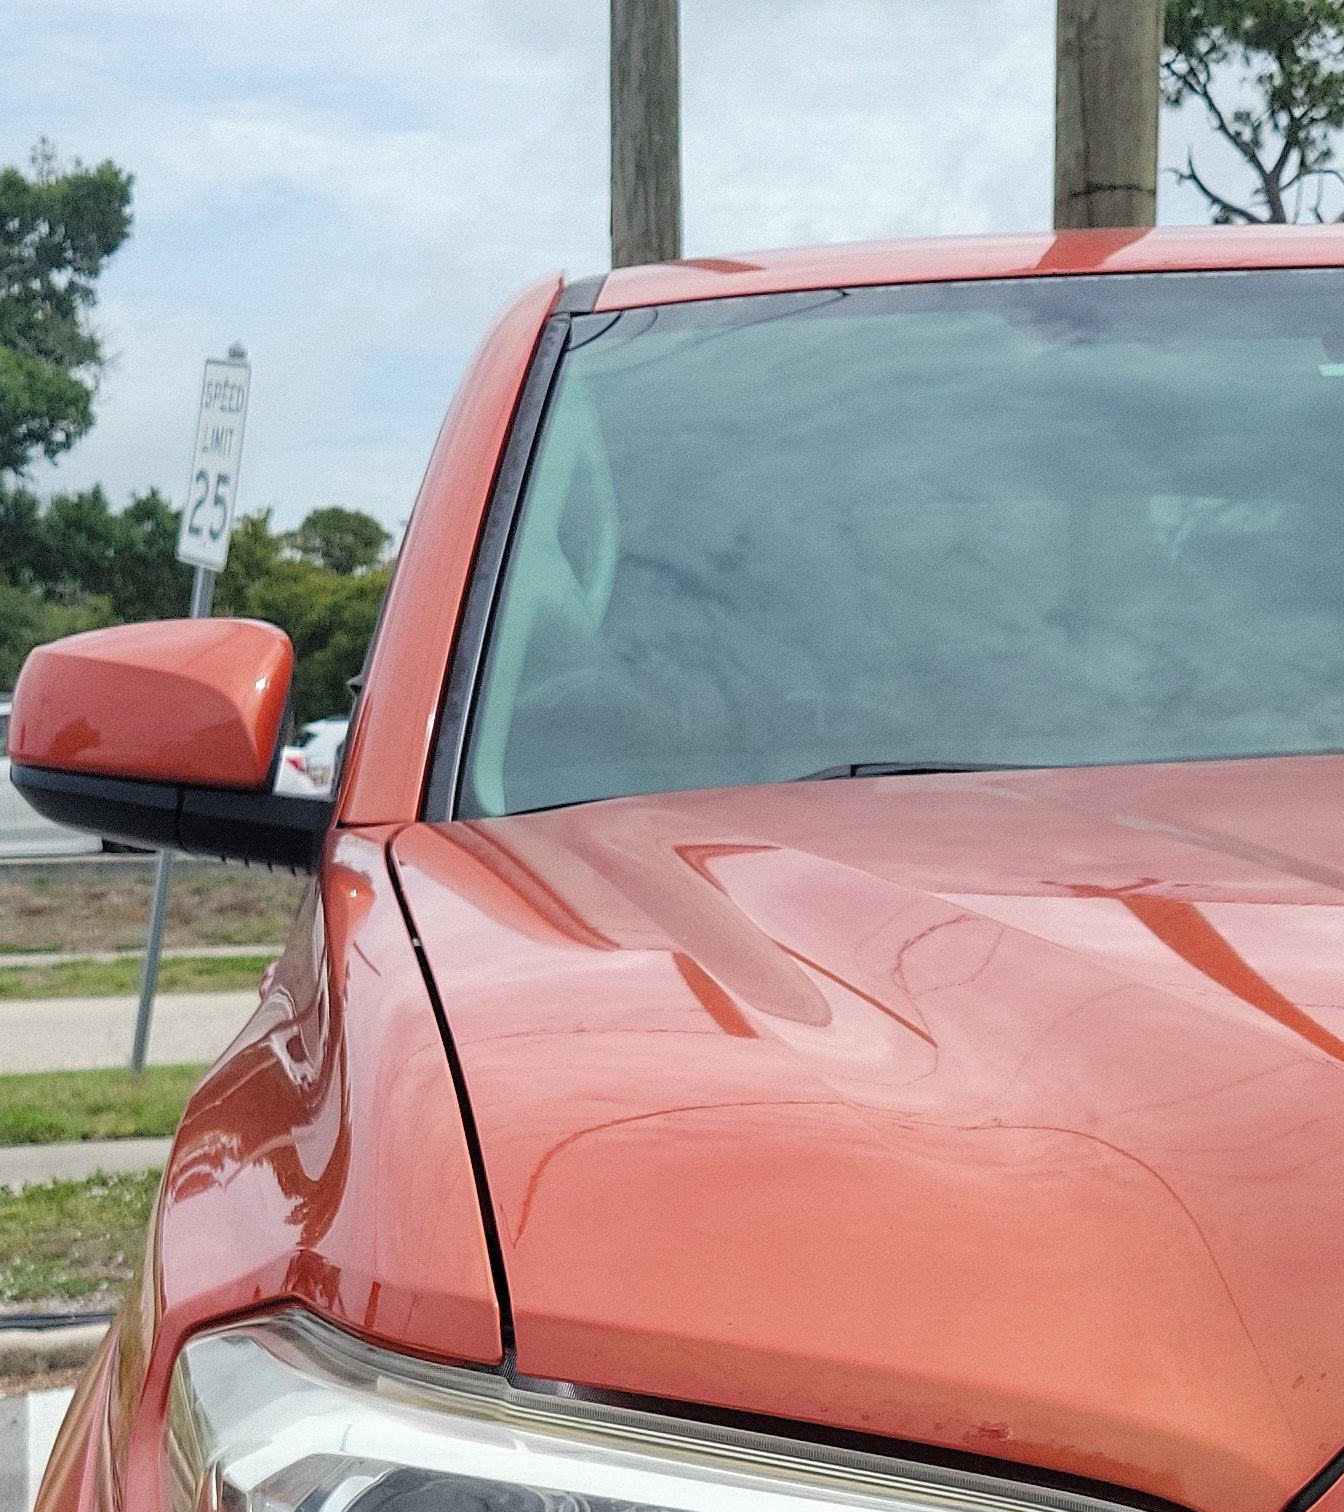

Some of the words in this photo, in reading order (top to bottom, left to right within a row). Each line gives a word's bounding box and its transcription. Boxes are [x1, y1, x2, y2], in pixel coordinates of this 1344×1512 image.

[205, 377, 244, 413] SPEED
[202, 426, 233, 455] LIMIT
[188, 469, 230, 540] 25
